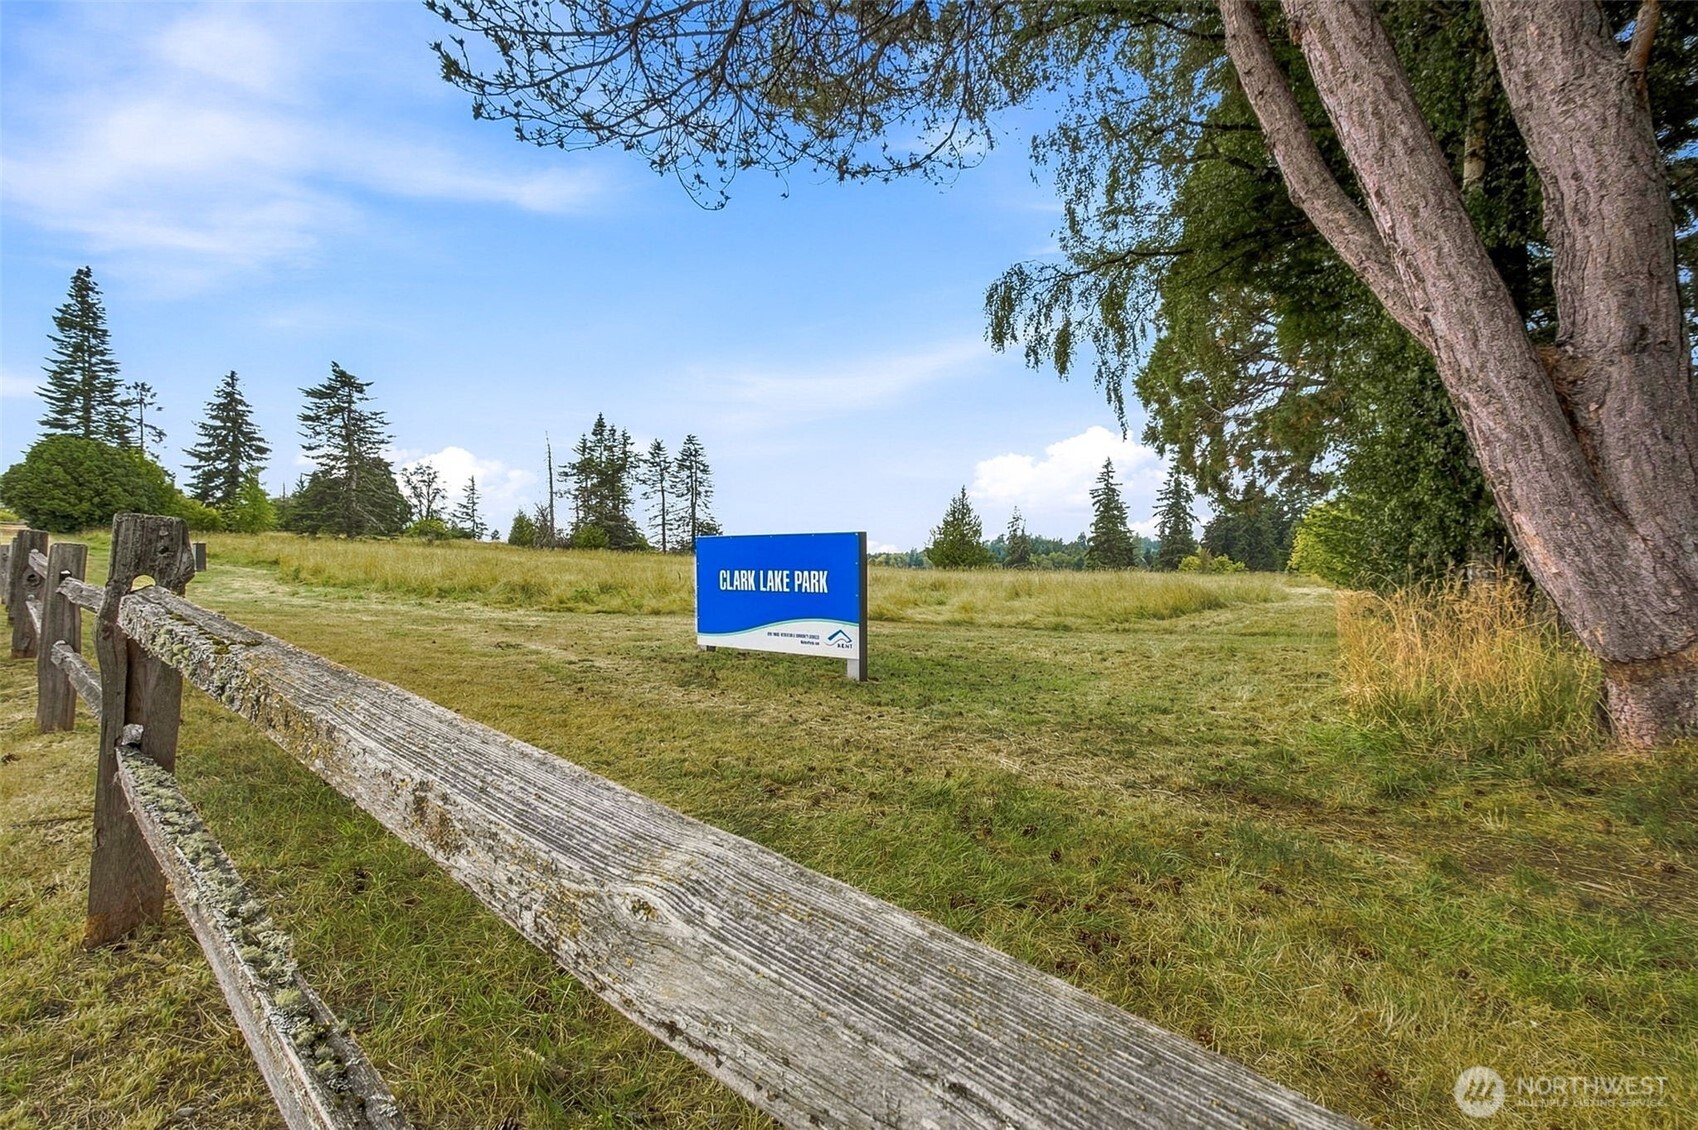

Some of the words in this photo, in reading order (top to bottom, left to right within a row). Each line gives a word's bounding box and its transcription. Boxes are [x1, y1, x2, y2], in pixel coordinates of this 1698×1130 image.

[719, 569, 756, 591] CLARK
[760, 569, 790, 592] LAKE
[794, 570, 828, 593] PARK
